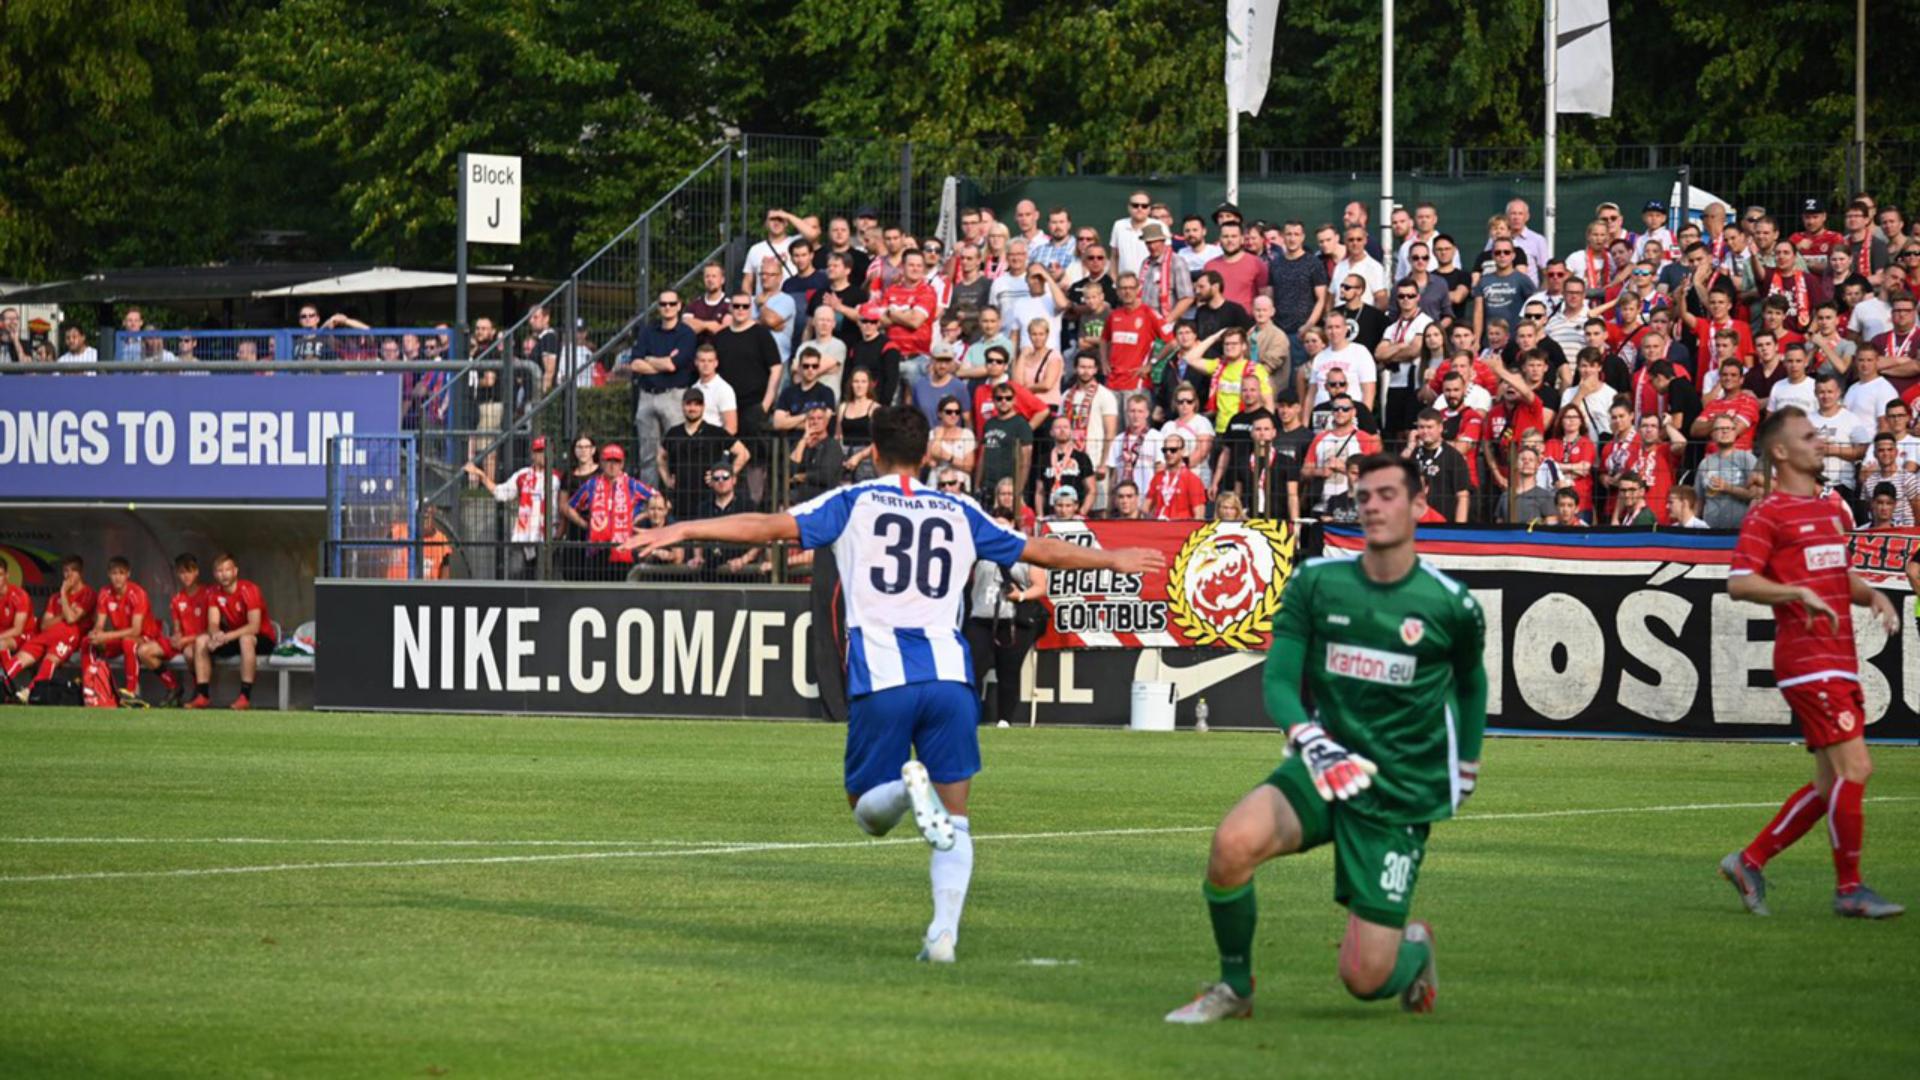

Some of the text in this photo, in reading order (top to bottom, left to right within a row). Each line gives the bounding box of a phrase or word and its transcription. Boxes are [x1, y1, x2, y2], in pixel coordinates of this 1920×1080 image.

[472, 164, 515, 185] Block
[487, 196, 501, 229] J
[0, 410, 367, 465] ONGS TO BERLIN.
[872, 492, 956, 512] HERTHA BSC
[870, 512, 954, 599] 36
[1049, 568, 1142, 595] EAGLES
[1056, 603, 1166, 630] COTTBUS
[1329, 651, 1412, 682] karton.eu
[1380, 851, 1411, 893] 30
